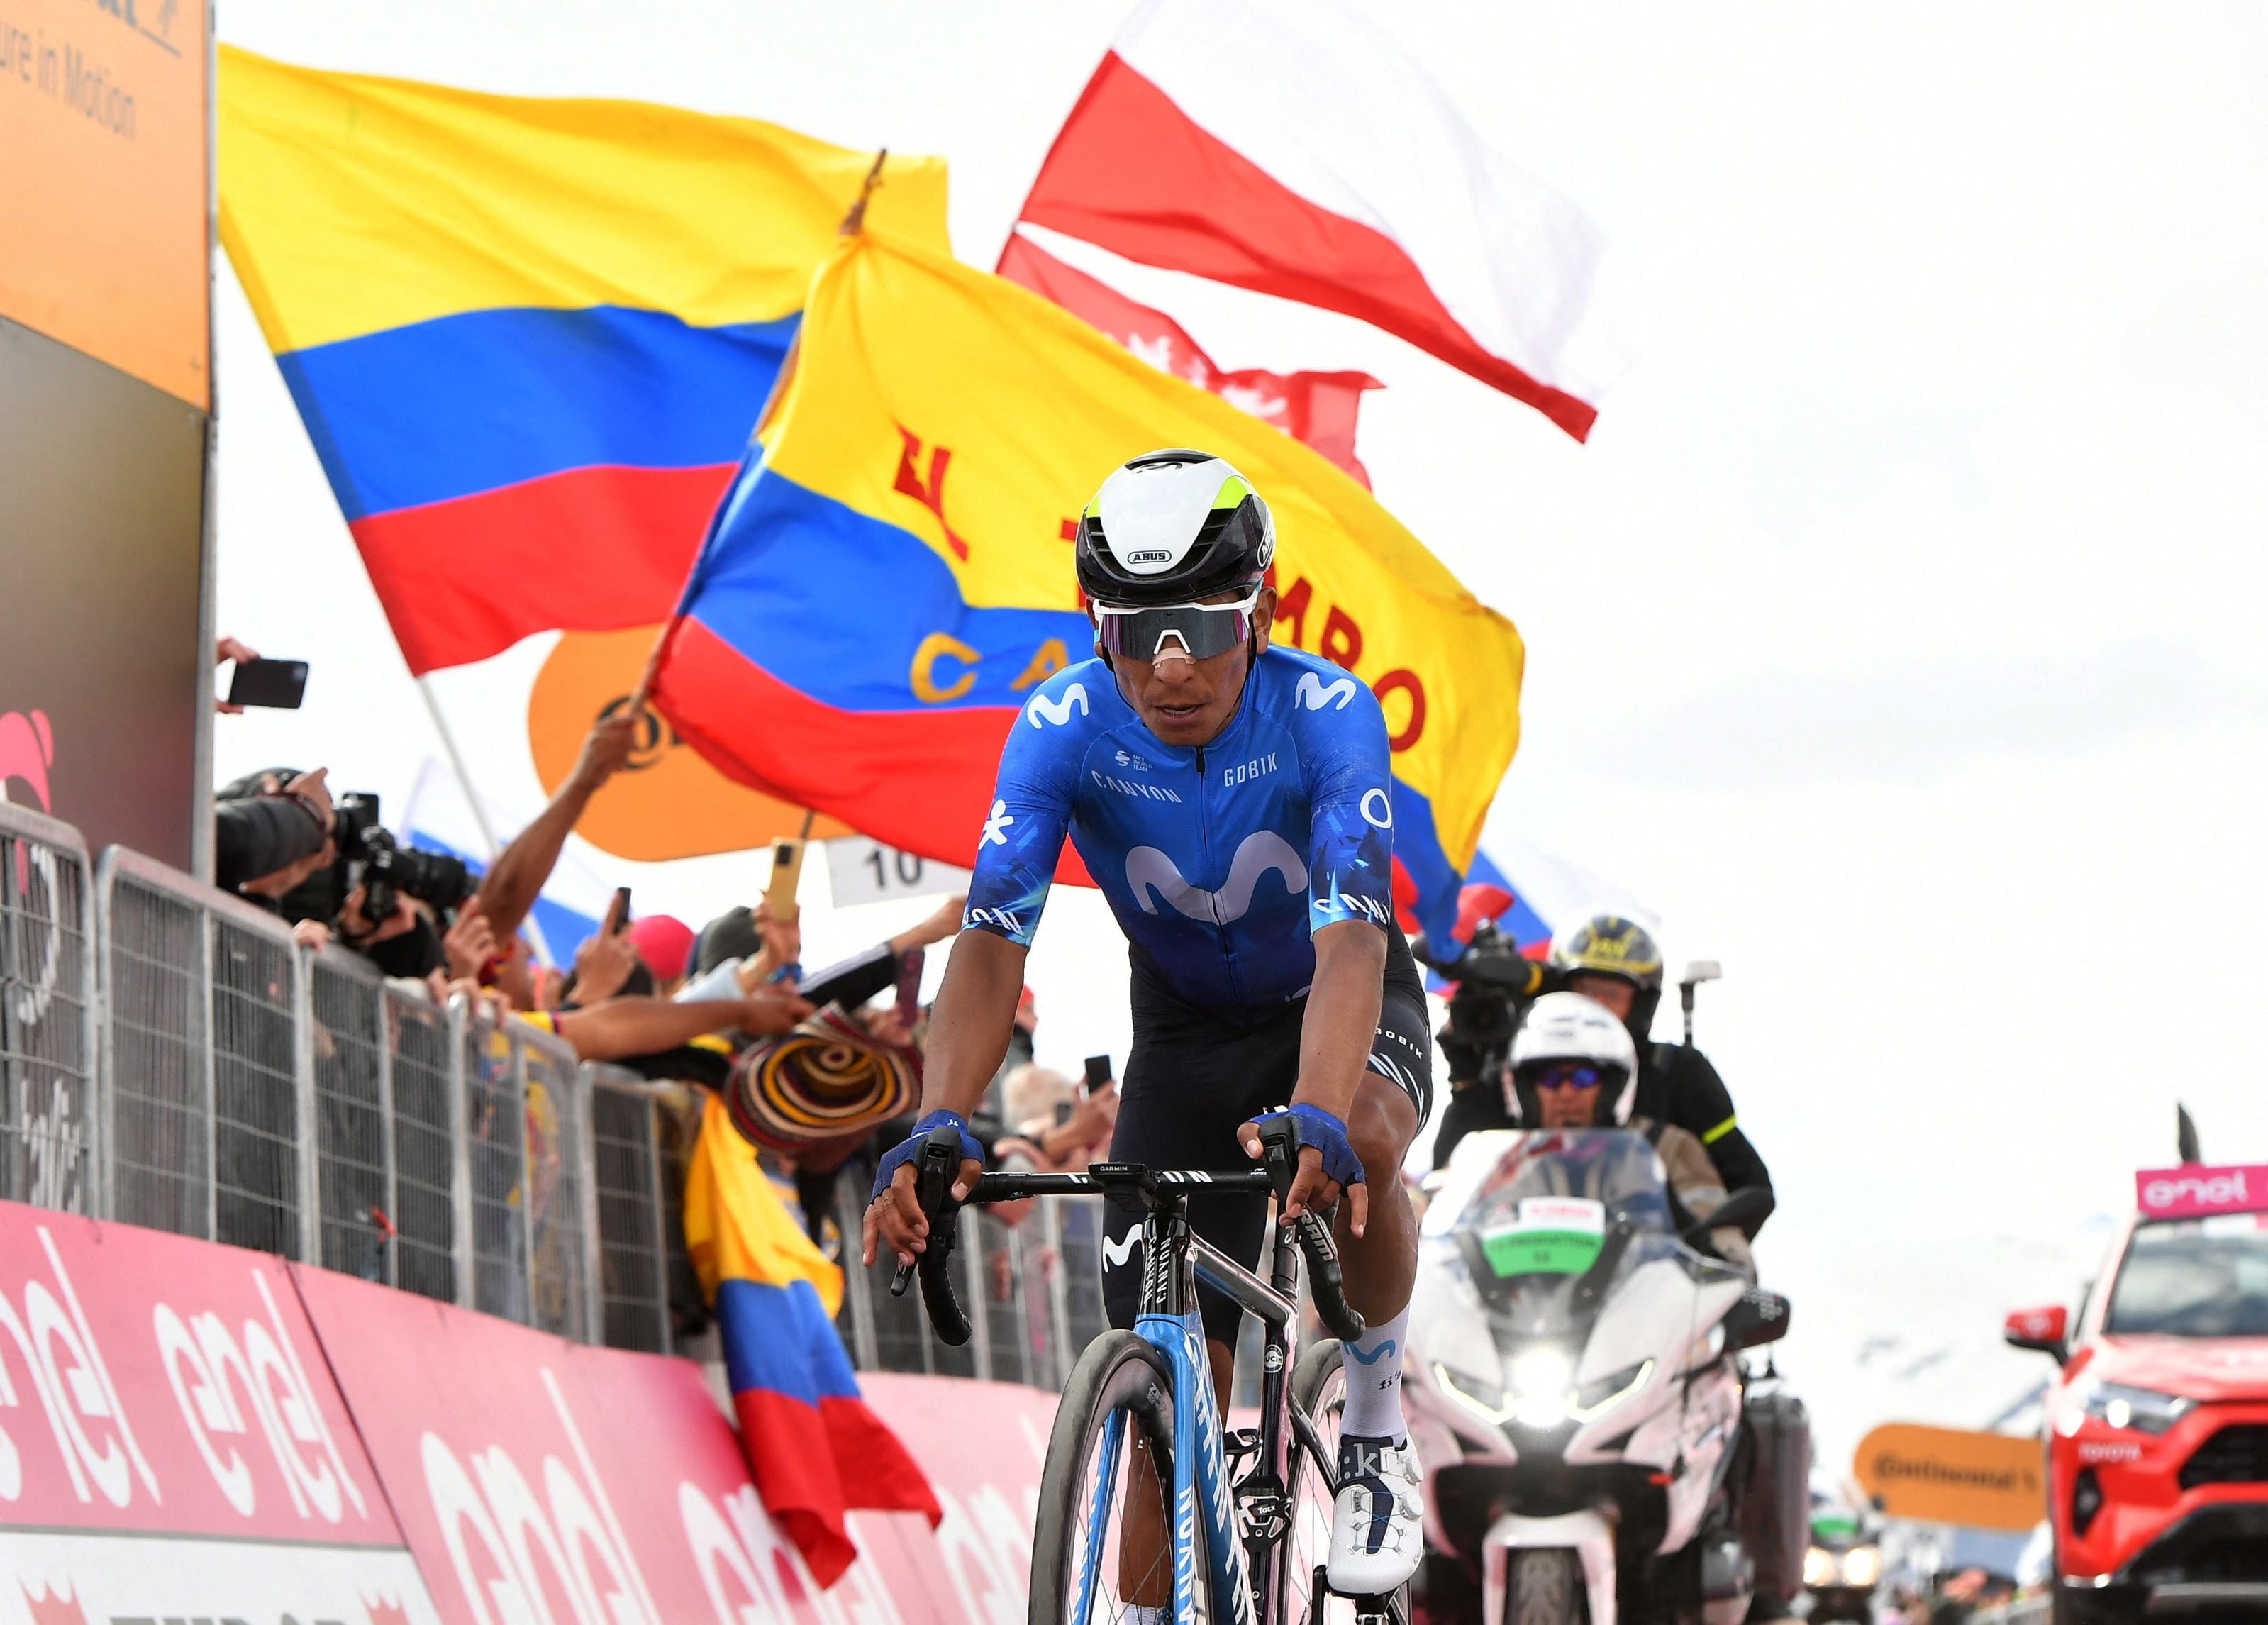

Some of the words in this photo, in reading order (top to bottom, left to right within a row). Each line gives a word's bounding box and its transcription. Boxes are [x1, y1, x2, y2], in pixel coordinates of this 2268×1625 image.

[63, 41, 137, 143] Motion
[1133, 553, 1166, 561] ABUS
[1091, 770, 1182, 804] CANYON
[1224, 752, 1277, 787] GOBIK
[2144, 1170, 2249, 1209] enel
[1301, 1209, 1334, 1261] RAM
[1155, 1236, 1172, 1304] CANYON
[0, 1226, 162, 1508] nel
[154, 1268, 367, 1523] enel
[1257, 1505, 1276, 1514] Tacx
